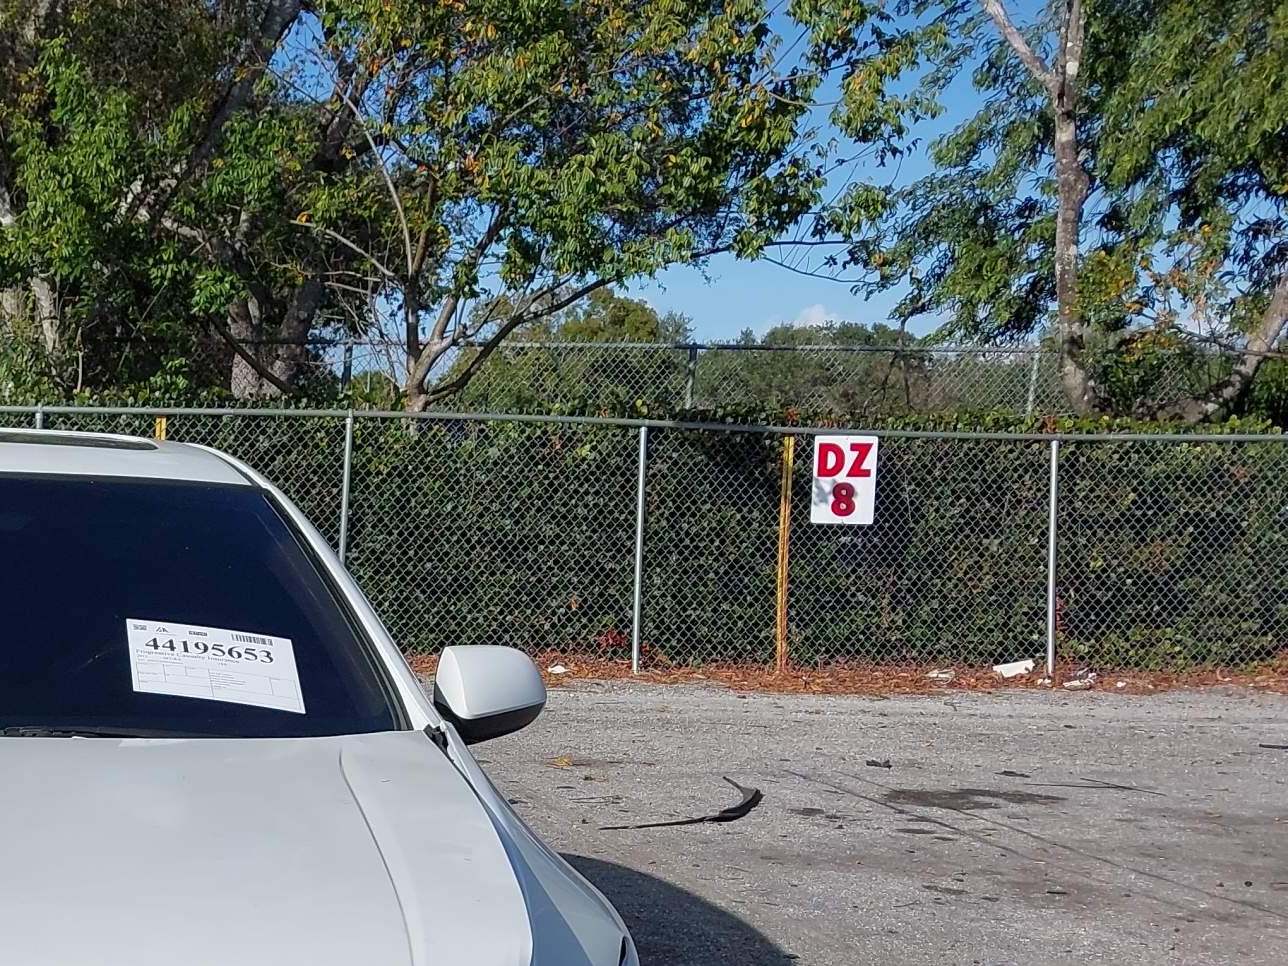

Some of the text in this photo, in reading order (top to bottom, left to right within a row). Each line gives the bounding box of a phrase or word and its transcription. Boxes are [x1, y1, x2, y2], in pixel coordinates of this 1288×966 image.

[817, 443, 874, 477] DZ
[831, 482, 856, 517] 8
[145, 637, 274, 664] 44195653
